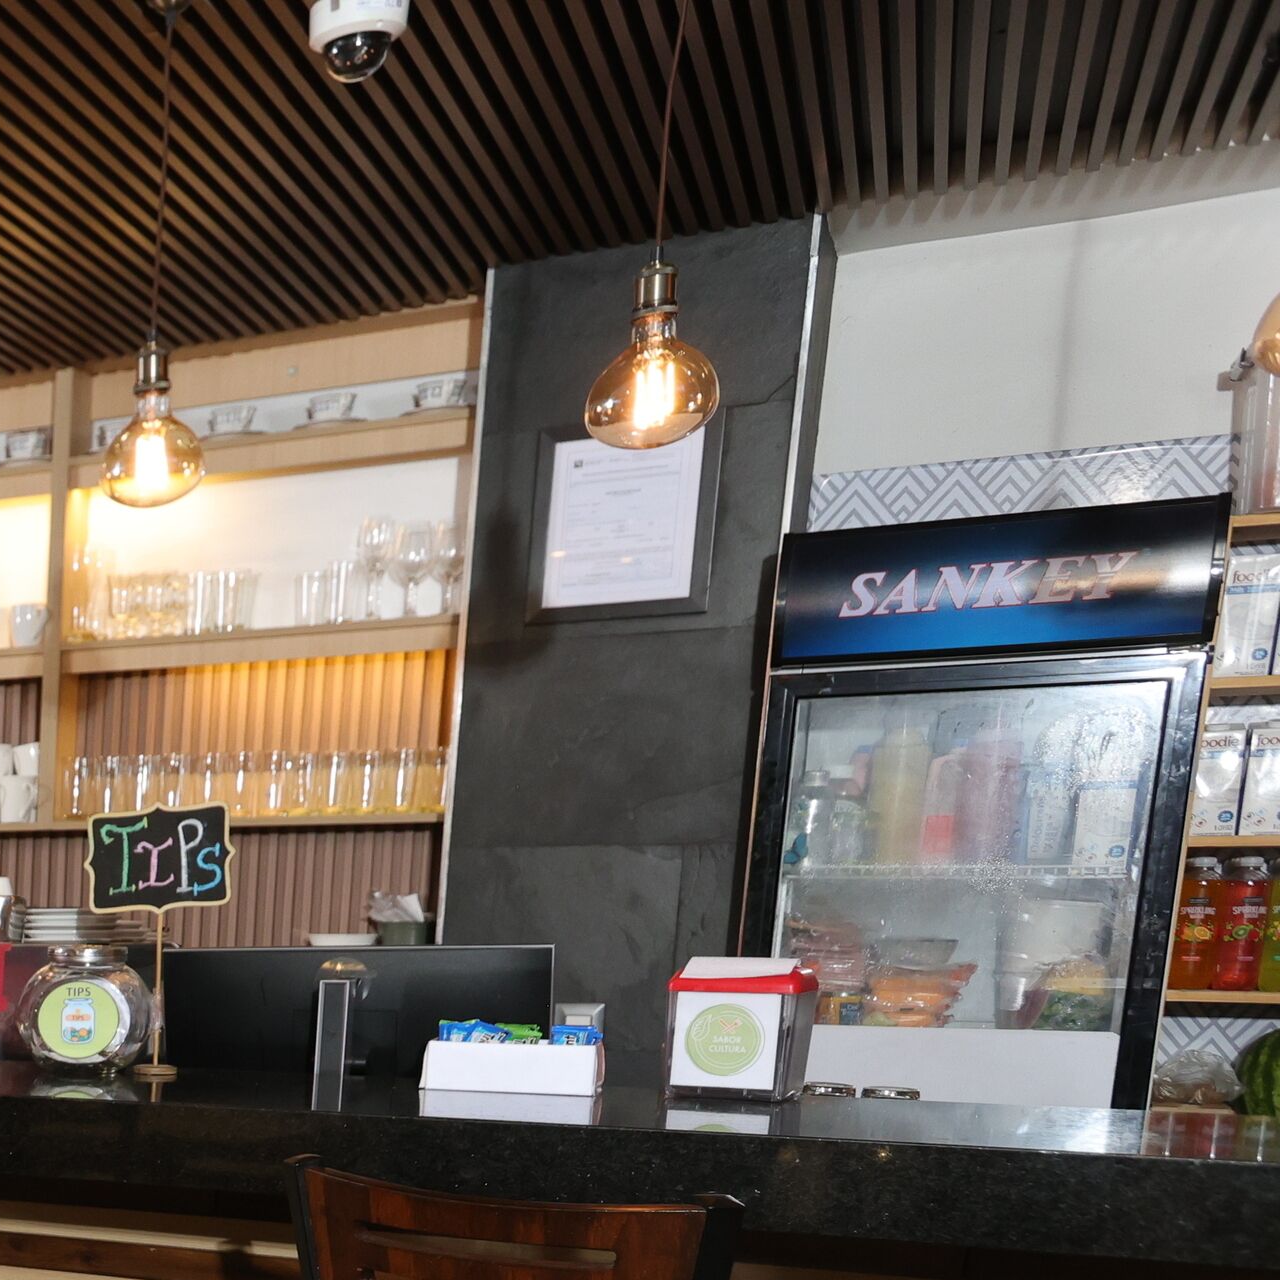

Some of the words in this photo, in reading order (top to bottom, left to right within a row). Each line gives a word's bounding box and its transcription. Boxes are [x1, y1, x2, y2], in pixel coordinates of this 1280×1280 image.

[837, 549, 1142, 620] SANKEY
[66, 987, 92, 997] TIPS
[712, 1035, 742, 1044] SABOR
[708, 1045, 747, 1054] CULTURA
